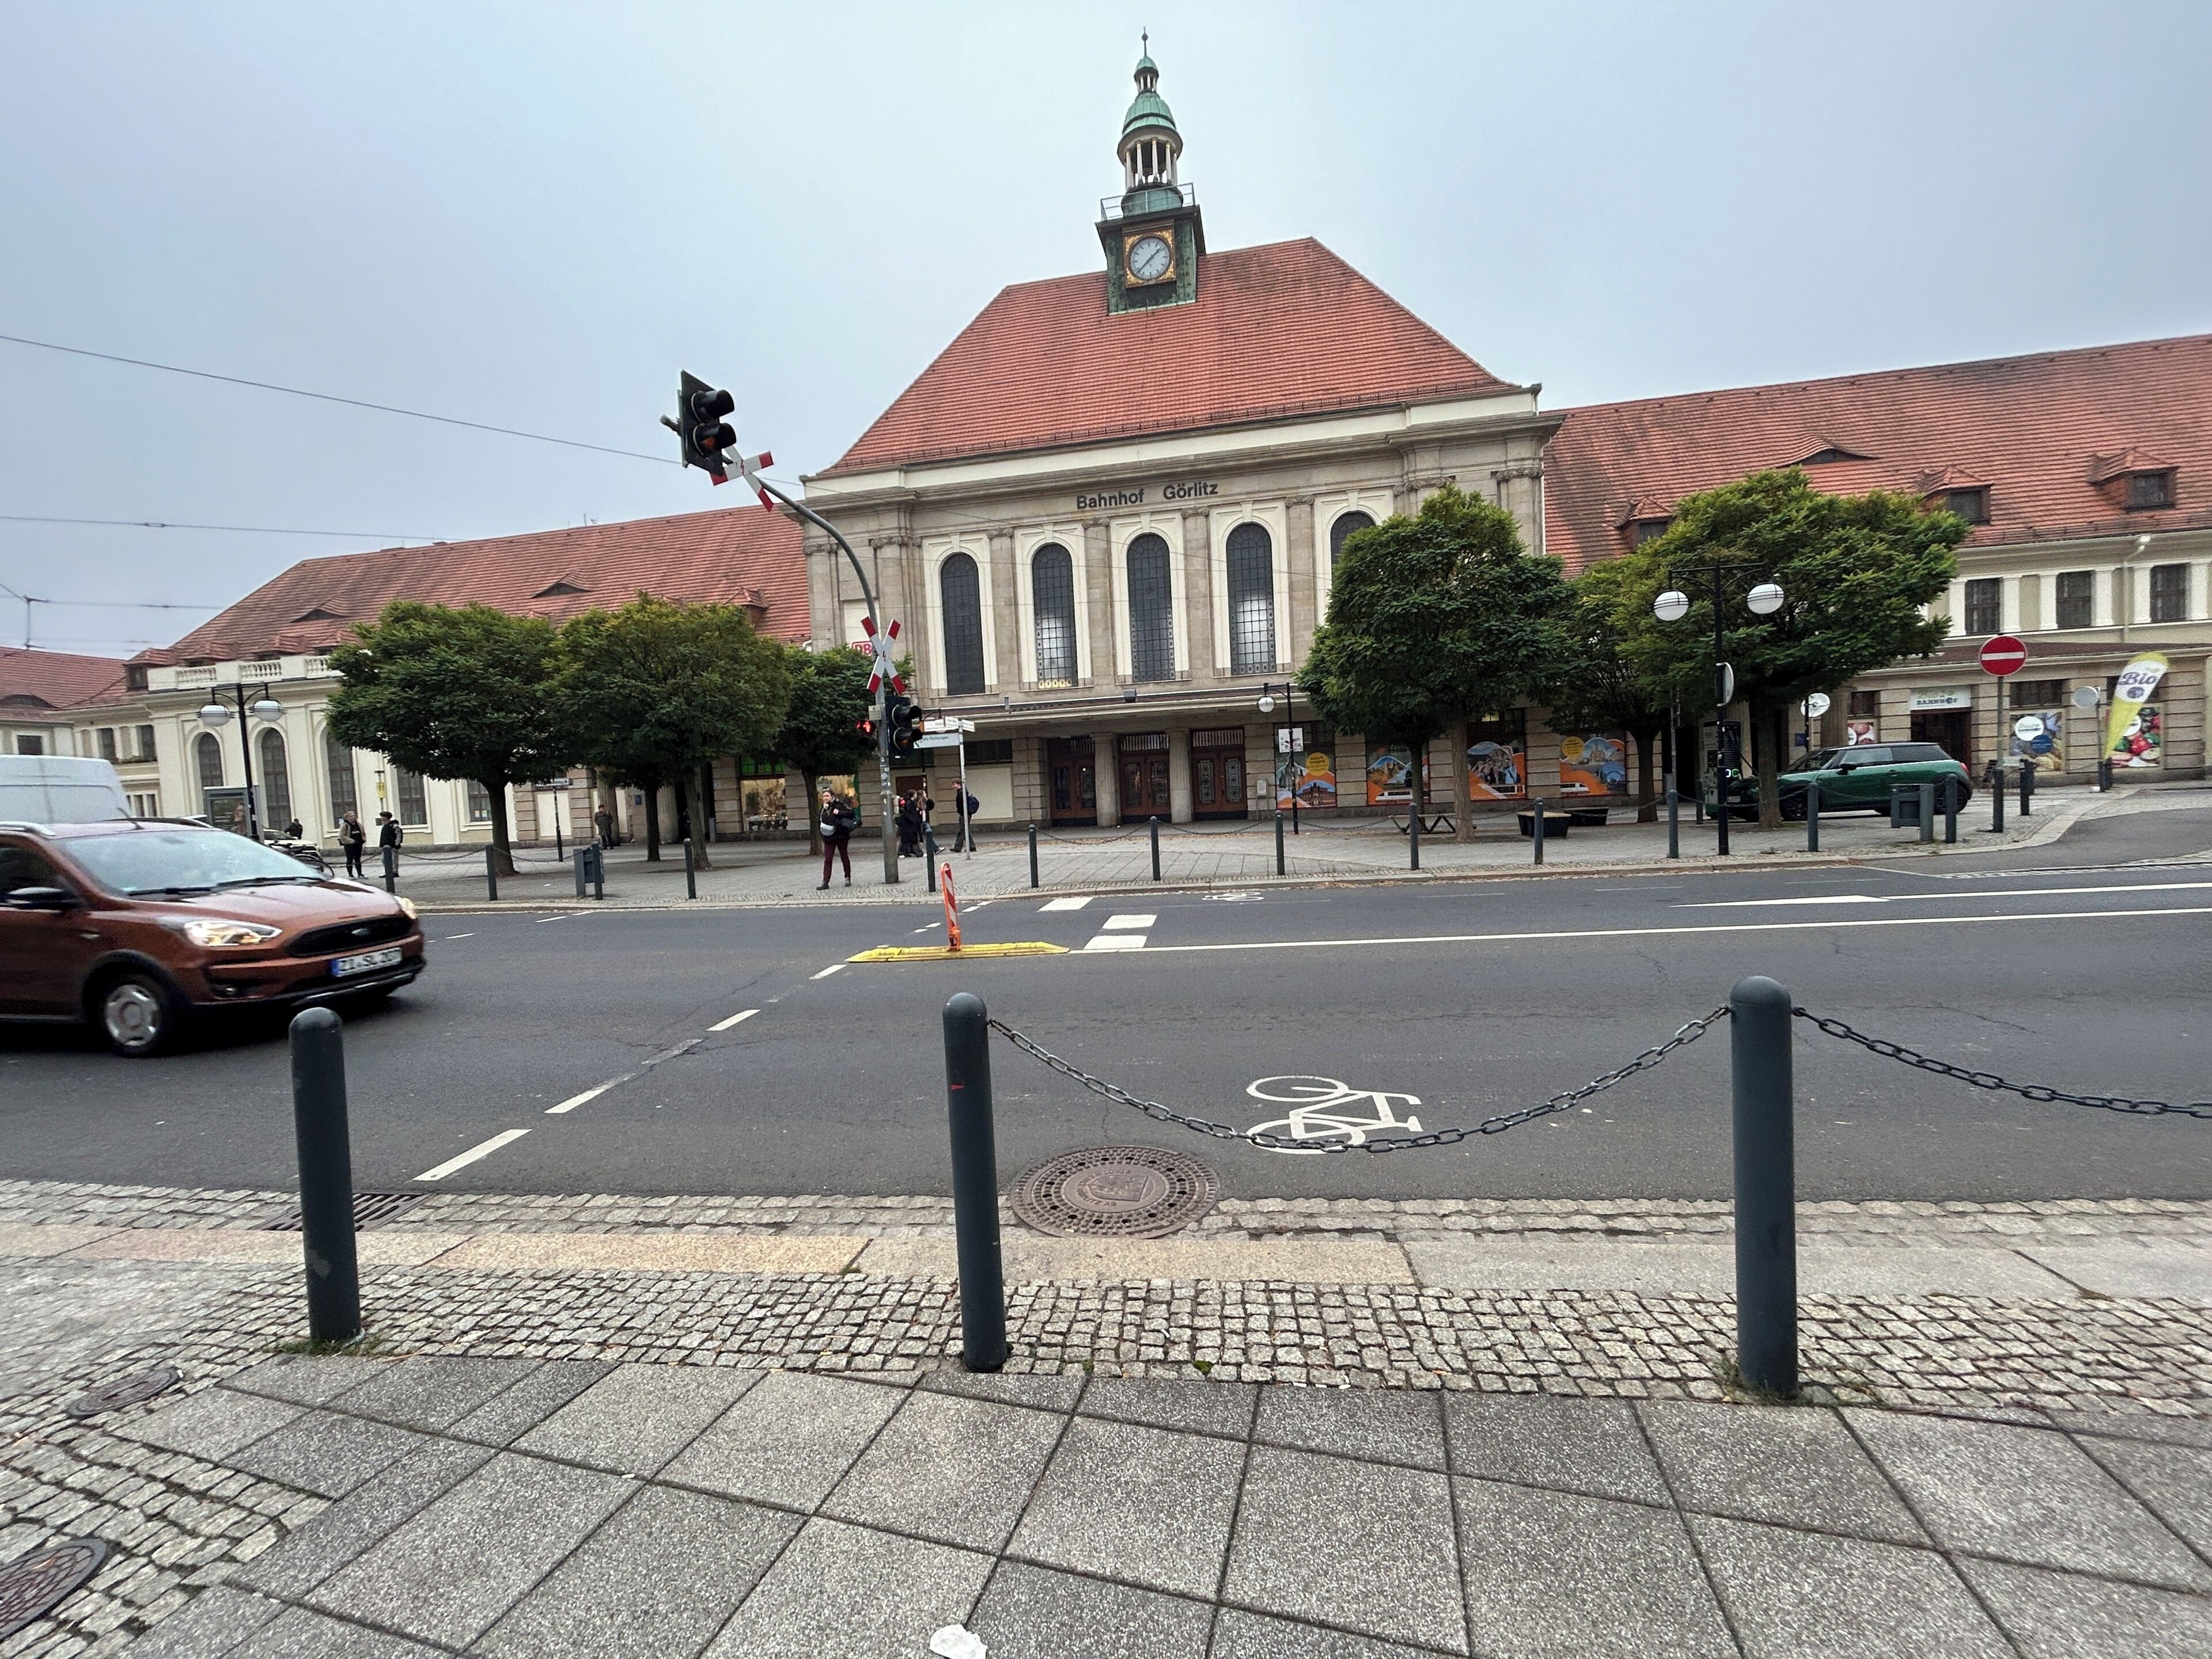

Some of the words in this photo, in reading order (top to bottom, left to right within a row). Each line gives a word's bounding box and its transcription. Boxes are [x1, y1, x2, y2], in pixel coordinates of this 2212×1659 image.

[1077, 488, 1144, 509] Bahnhof
[1163, 482, 1218, 500] Görlitz
[2118, 672, 2157, 685] Bio
